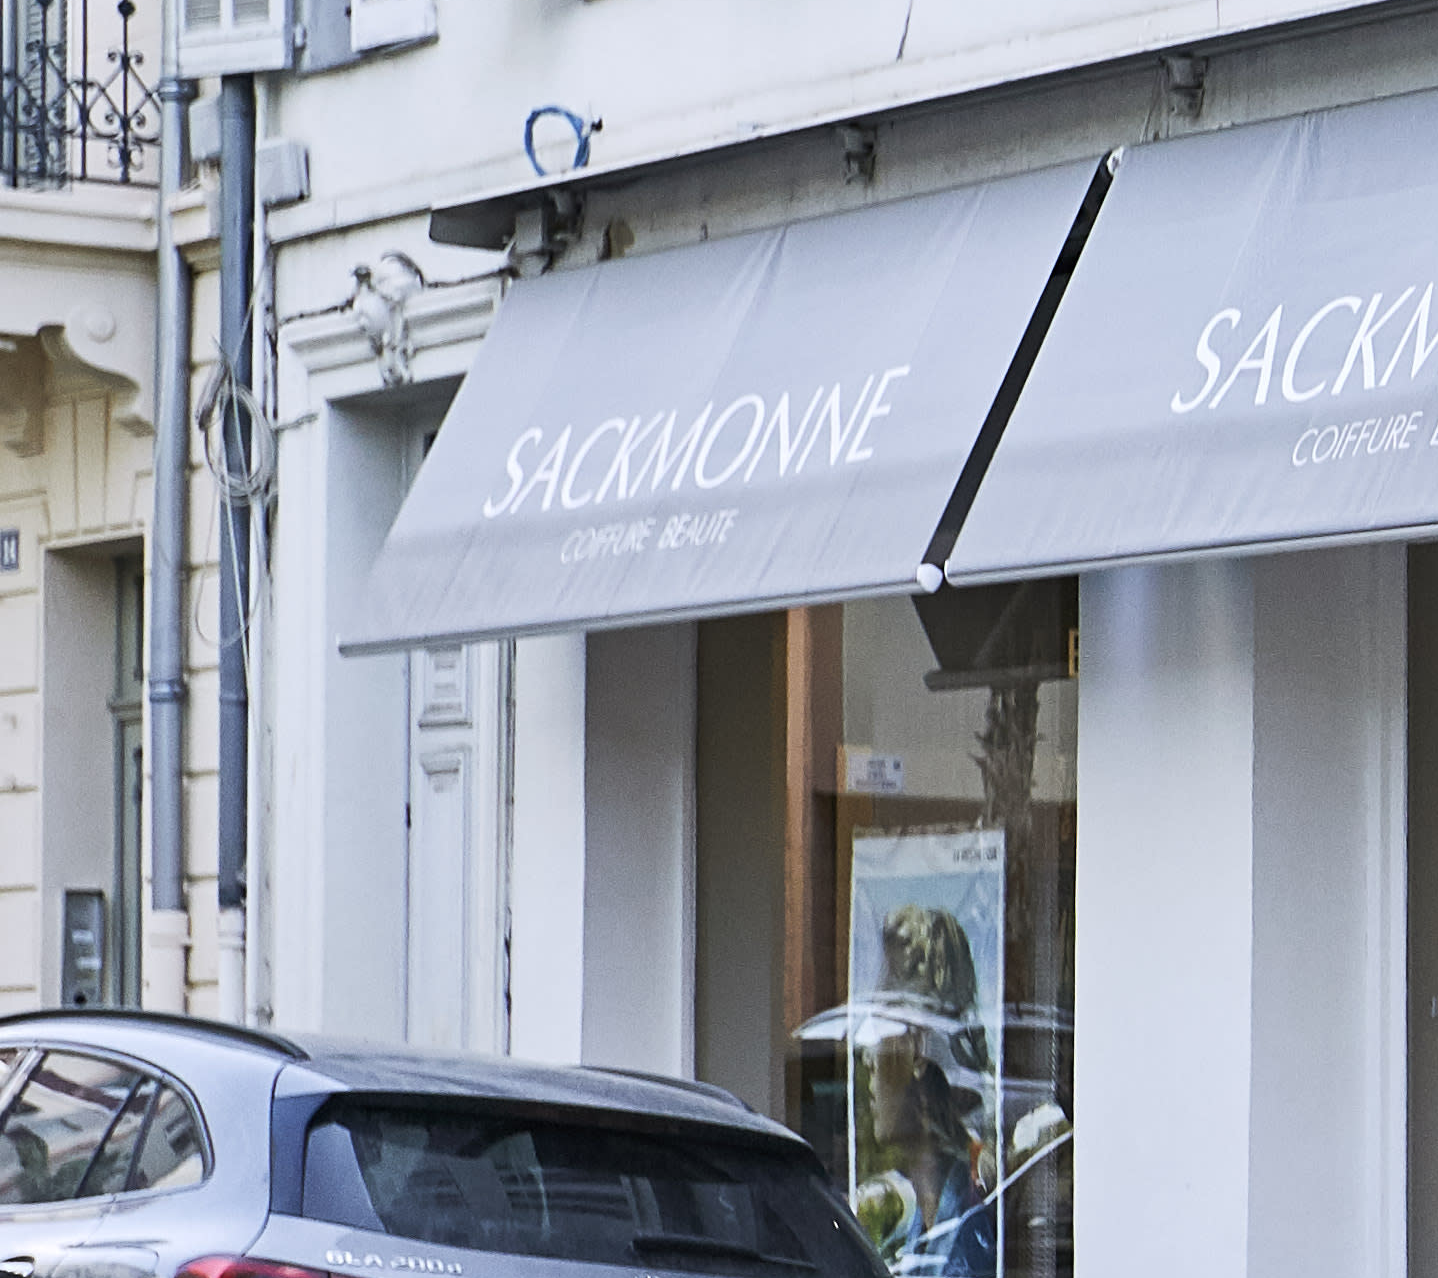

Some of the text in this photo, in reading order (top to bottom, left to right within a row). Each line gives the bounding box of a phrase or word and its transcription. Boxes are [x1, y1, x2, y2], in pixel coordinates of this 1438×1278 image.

[483, 365, 910, 519] SACKMONNE
[1292, 411, 1424, 467] COIFFURE
[657, 509, 740, 551] BEAUTE
